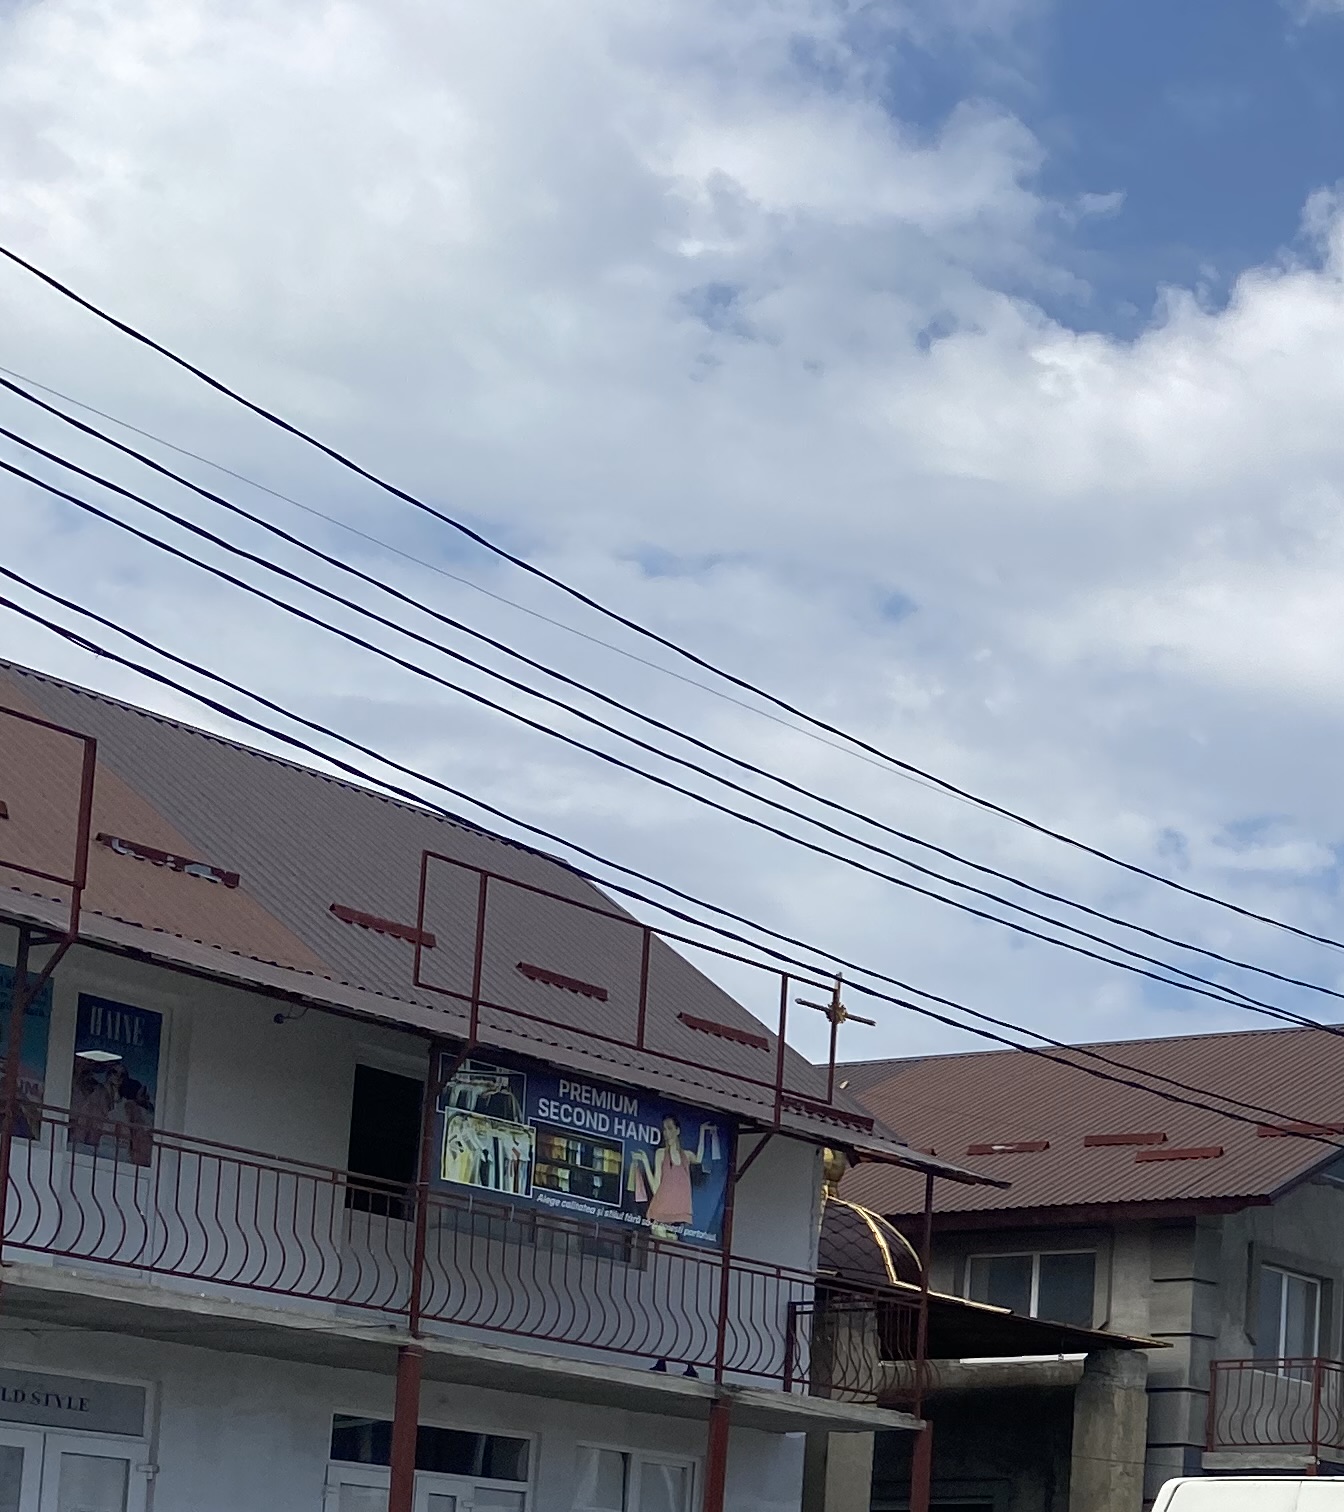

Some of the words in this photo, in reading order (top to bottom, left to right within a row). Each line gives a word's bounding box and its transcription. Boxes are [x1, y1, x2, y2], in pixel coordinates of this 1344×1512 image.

[558, 1079, 638, 1117] PREMIUM
[537, 1098, 610, 1132] SECOND
[613, 1117, 662, 1146] HAND
[30, 1390, 90, 1412] STYLE
